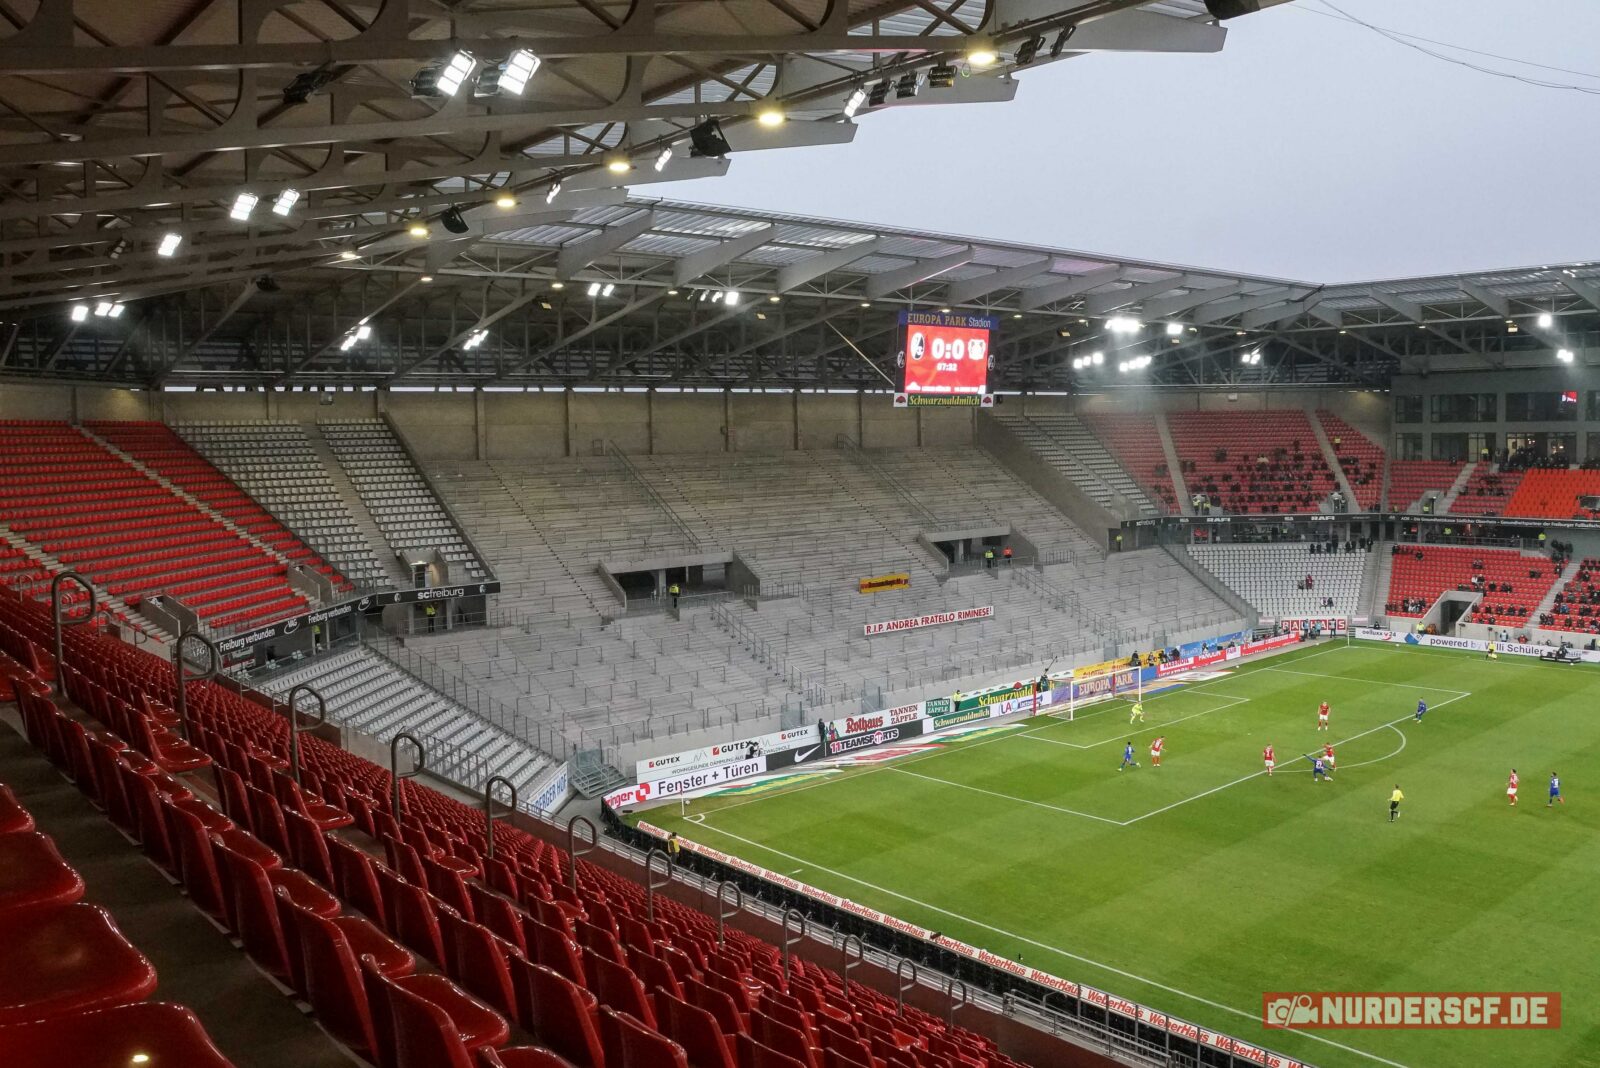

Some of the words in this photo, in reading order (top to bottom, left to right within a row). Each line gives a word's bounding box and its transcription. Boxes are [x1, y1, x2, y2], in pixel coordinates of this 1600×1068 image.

[908, 313, 942, 325] EUROPA
[945, 316, 967, 326] PARK
[968, 317, 991, 328] Stadion
[931, 338, 965, 359] 0:0
[909, 395, 980, 405] Schwarzwaldmilch
[308, 612, 328, 624] Freiburg
[328, 604, 351, 618] verbunden
[886, 619, 919, 631] ANDREA
[921, 613, 955, 626] FRATELLO
[958, 607, 992, 620] RIMINESE!
[220, 638, 245, 653] Freiburg
[245, 628, 276, 644] verbunden
[1430, 638, 1468, 648] powered
[1507, 644, 1543, 655] Schüler
[1079, 678, 1111, 695] EUROPA
[889, 705, 918, 717] TANNEN
[934, 708, 990, 728] Schwarzwaldmilch
[845, 716, 884, 733] Rothaus
[787, 729, 809, 739] GUTEX
[721, 741, 751, 753] GUTEX
[655, 756, 681, 767] GUTEX
[556, 773, 567, 795] HOF
[658, 773, 708, 795] Fenster
[712, 771, 719, 780] +
[723, 761, 759, 779] Türen
[697, 845, 727, 861] WeberHaus
[764, 870, 799, 890] WeberHaus
[801, 884, 838, 905] WeberHaus
[840, 899, 881, 921] WeberHaus
[883, 915, 925, 938] WeberHaus
[978, 950, 1027, 976] WeberHaus
